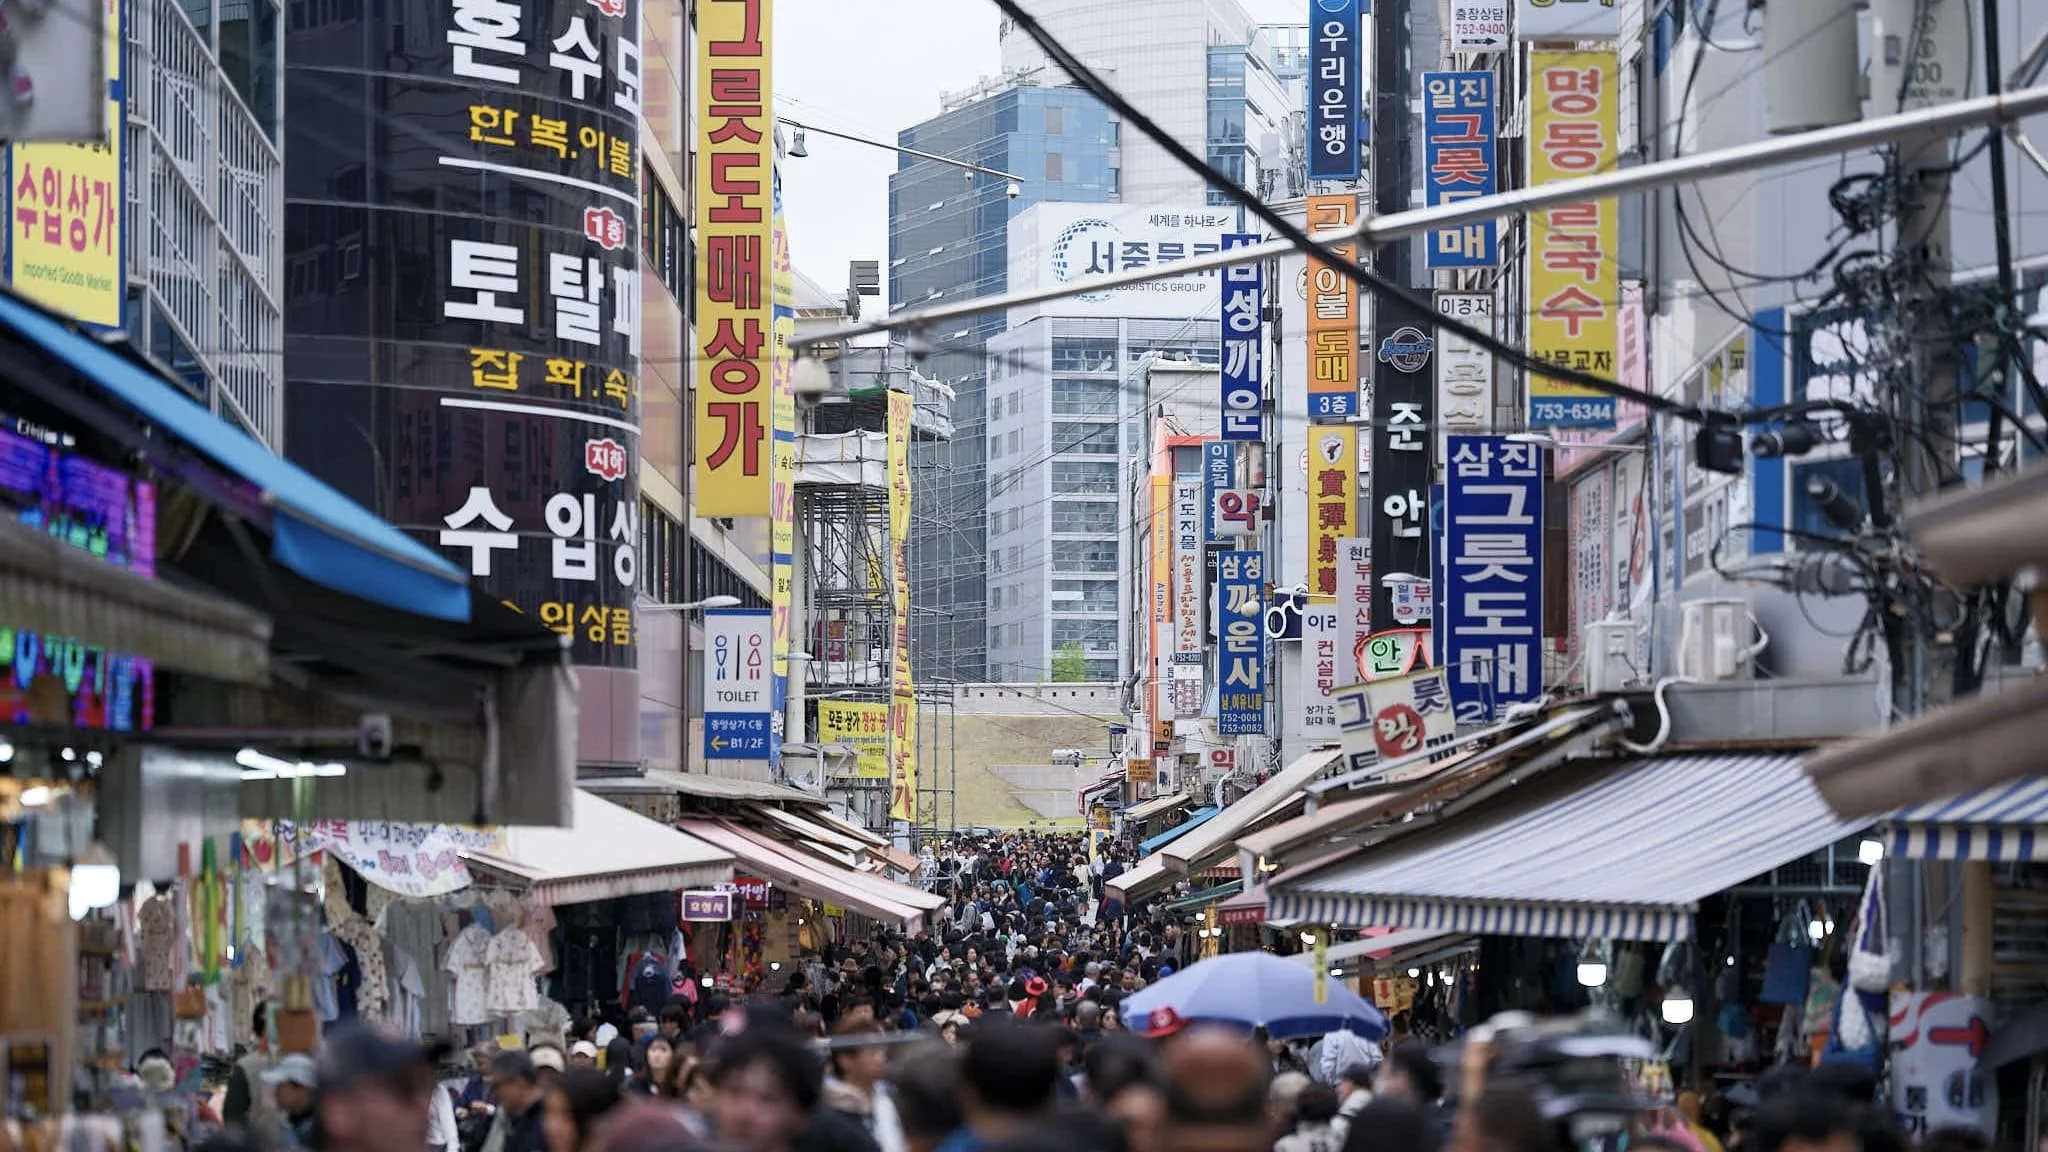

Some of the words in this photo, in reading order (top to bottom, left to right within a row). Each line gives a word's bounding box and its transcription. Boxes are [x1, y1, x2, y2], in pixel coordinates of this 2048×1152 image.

[1456, 8, 1504, 21] 출장상담
[1456, 24, 1505, 34] 752-9400
[1319, 20, 1347, 155] 우리은행
[1428, 79, 1488, 108] 일진
[17, 163, 115, 257] 수입상가
[1150, 214, 1179, 227] 세계를
[1184, 214, 1215, 227] 하나로
[704, 0, 764, 476] 그릇도매상가
[1170, 283, 1206, 293] GROUP
[1441, 298, 1491, 315] 이경자
[1315, 330, 1349, 382] 도매
[1319, 396, 1347, 414] 3층
[1535, 403, 1611, 420] 753-6344
[592, 447, 624, 472] 지하
[1452, 443, 1537, 477] 삼진
[1219, 492, 1260, 532] 약
[1221, 556, 1261, 579] 삼성
[1455, 485, 1534, 695] 그릇도매
[1317, 640, 1334, 697] 컨설팅
[717, 690, 759, 702] TOILET
[828, 710, 842, 731] 모든
